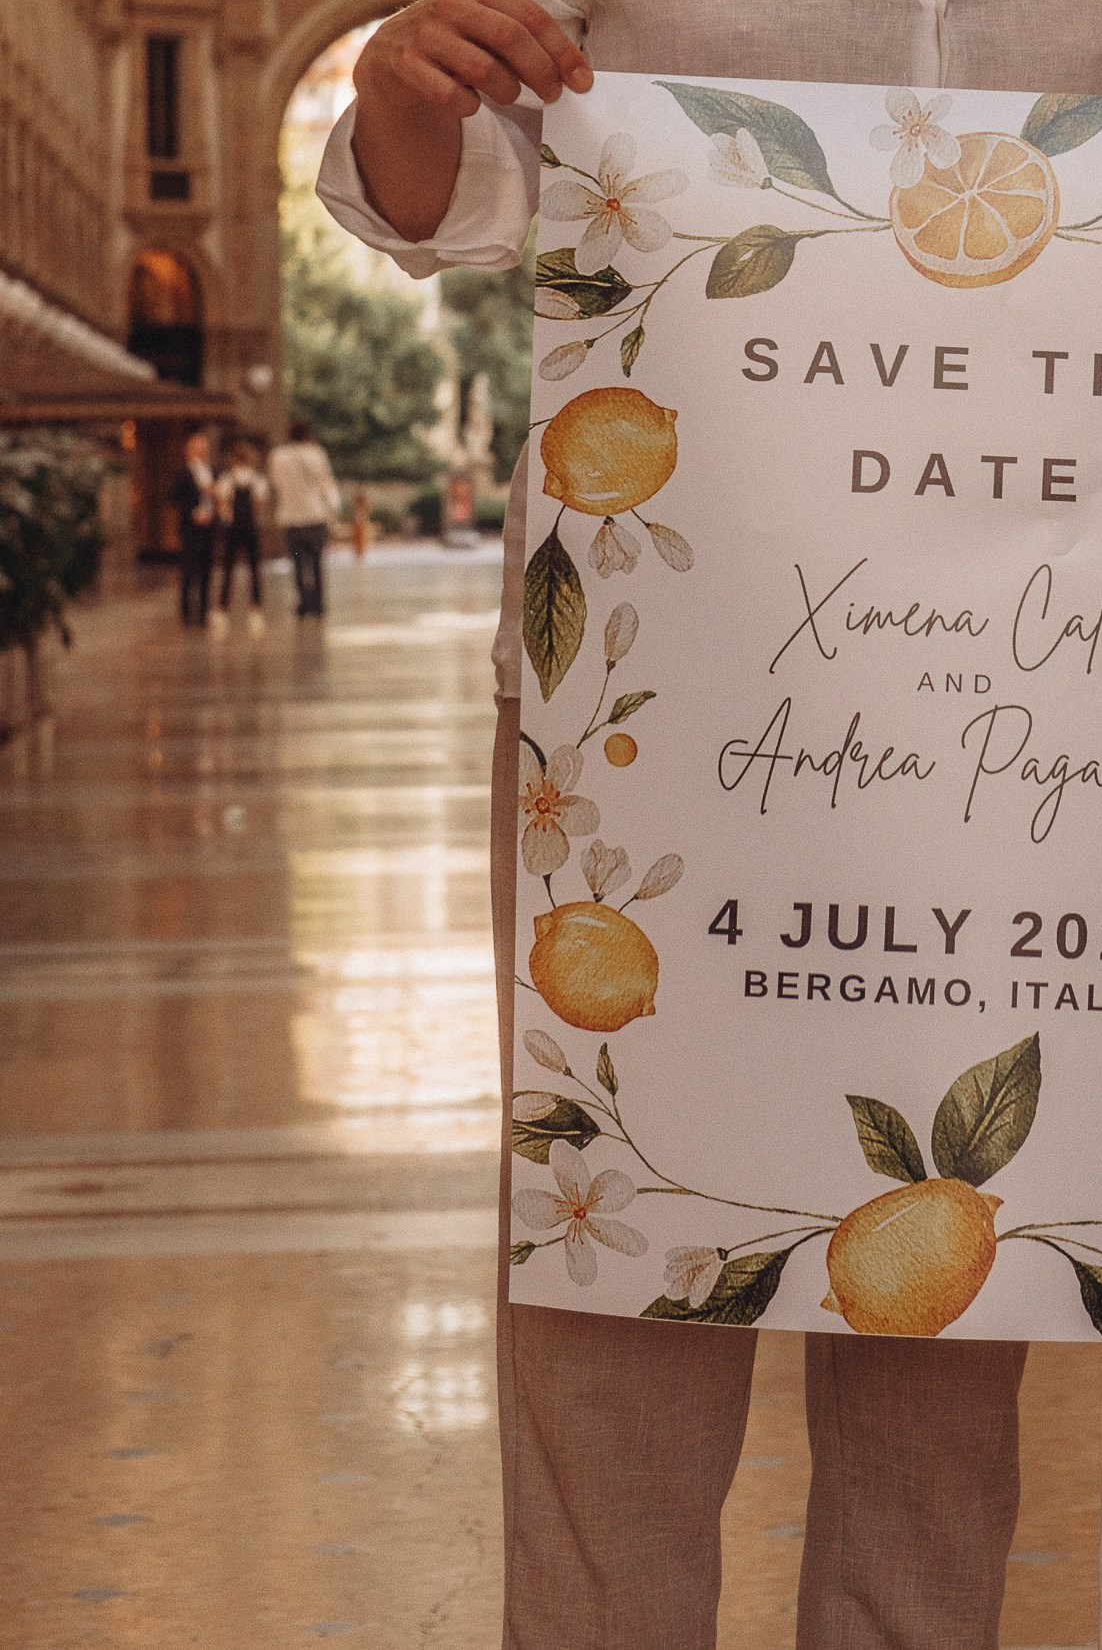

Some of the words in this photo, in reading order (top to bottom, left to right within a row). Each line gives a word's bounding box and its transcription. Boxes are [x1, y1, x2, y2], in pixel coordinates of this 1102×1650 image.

[741, 337, 969, 391] SAVE
[851, 449, 1077, 503] DATE
[768, 557, 990, 675] Ximena
[917, 672, 991, 694] AND
[717, 696, 936, 815] Andrea
[707, 898, 744, 946] 4
[780, 902, 972, 955] JULY
[744, 969, 986, 1013] BERGAMO,
